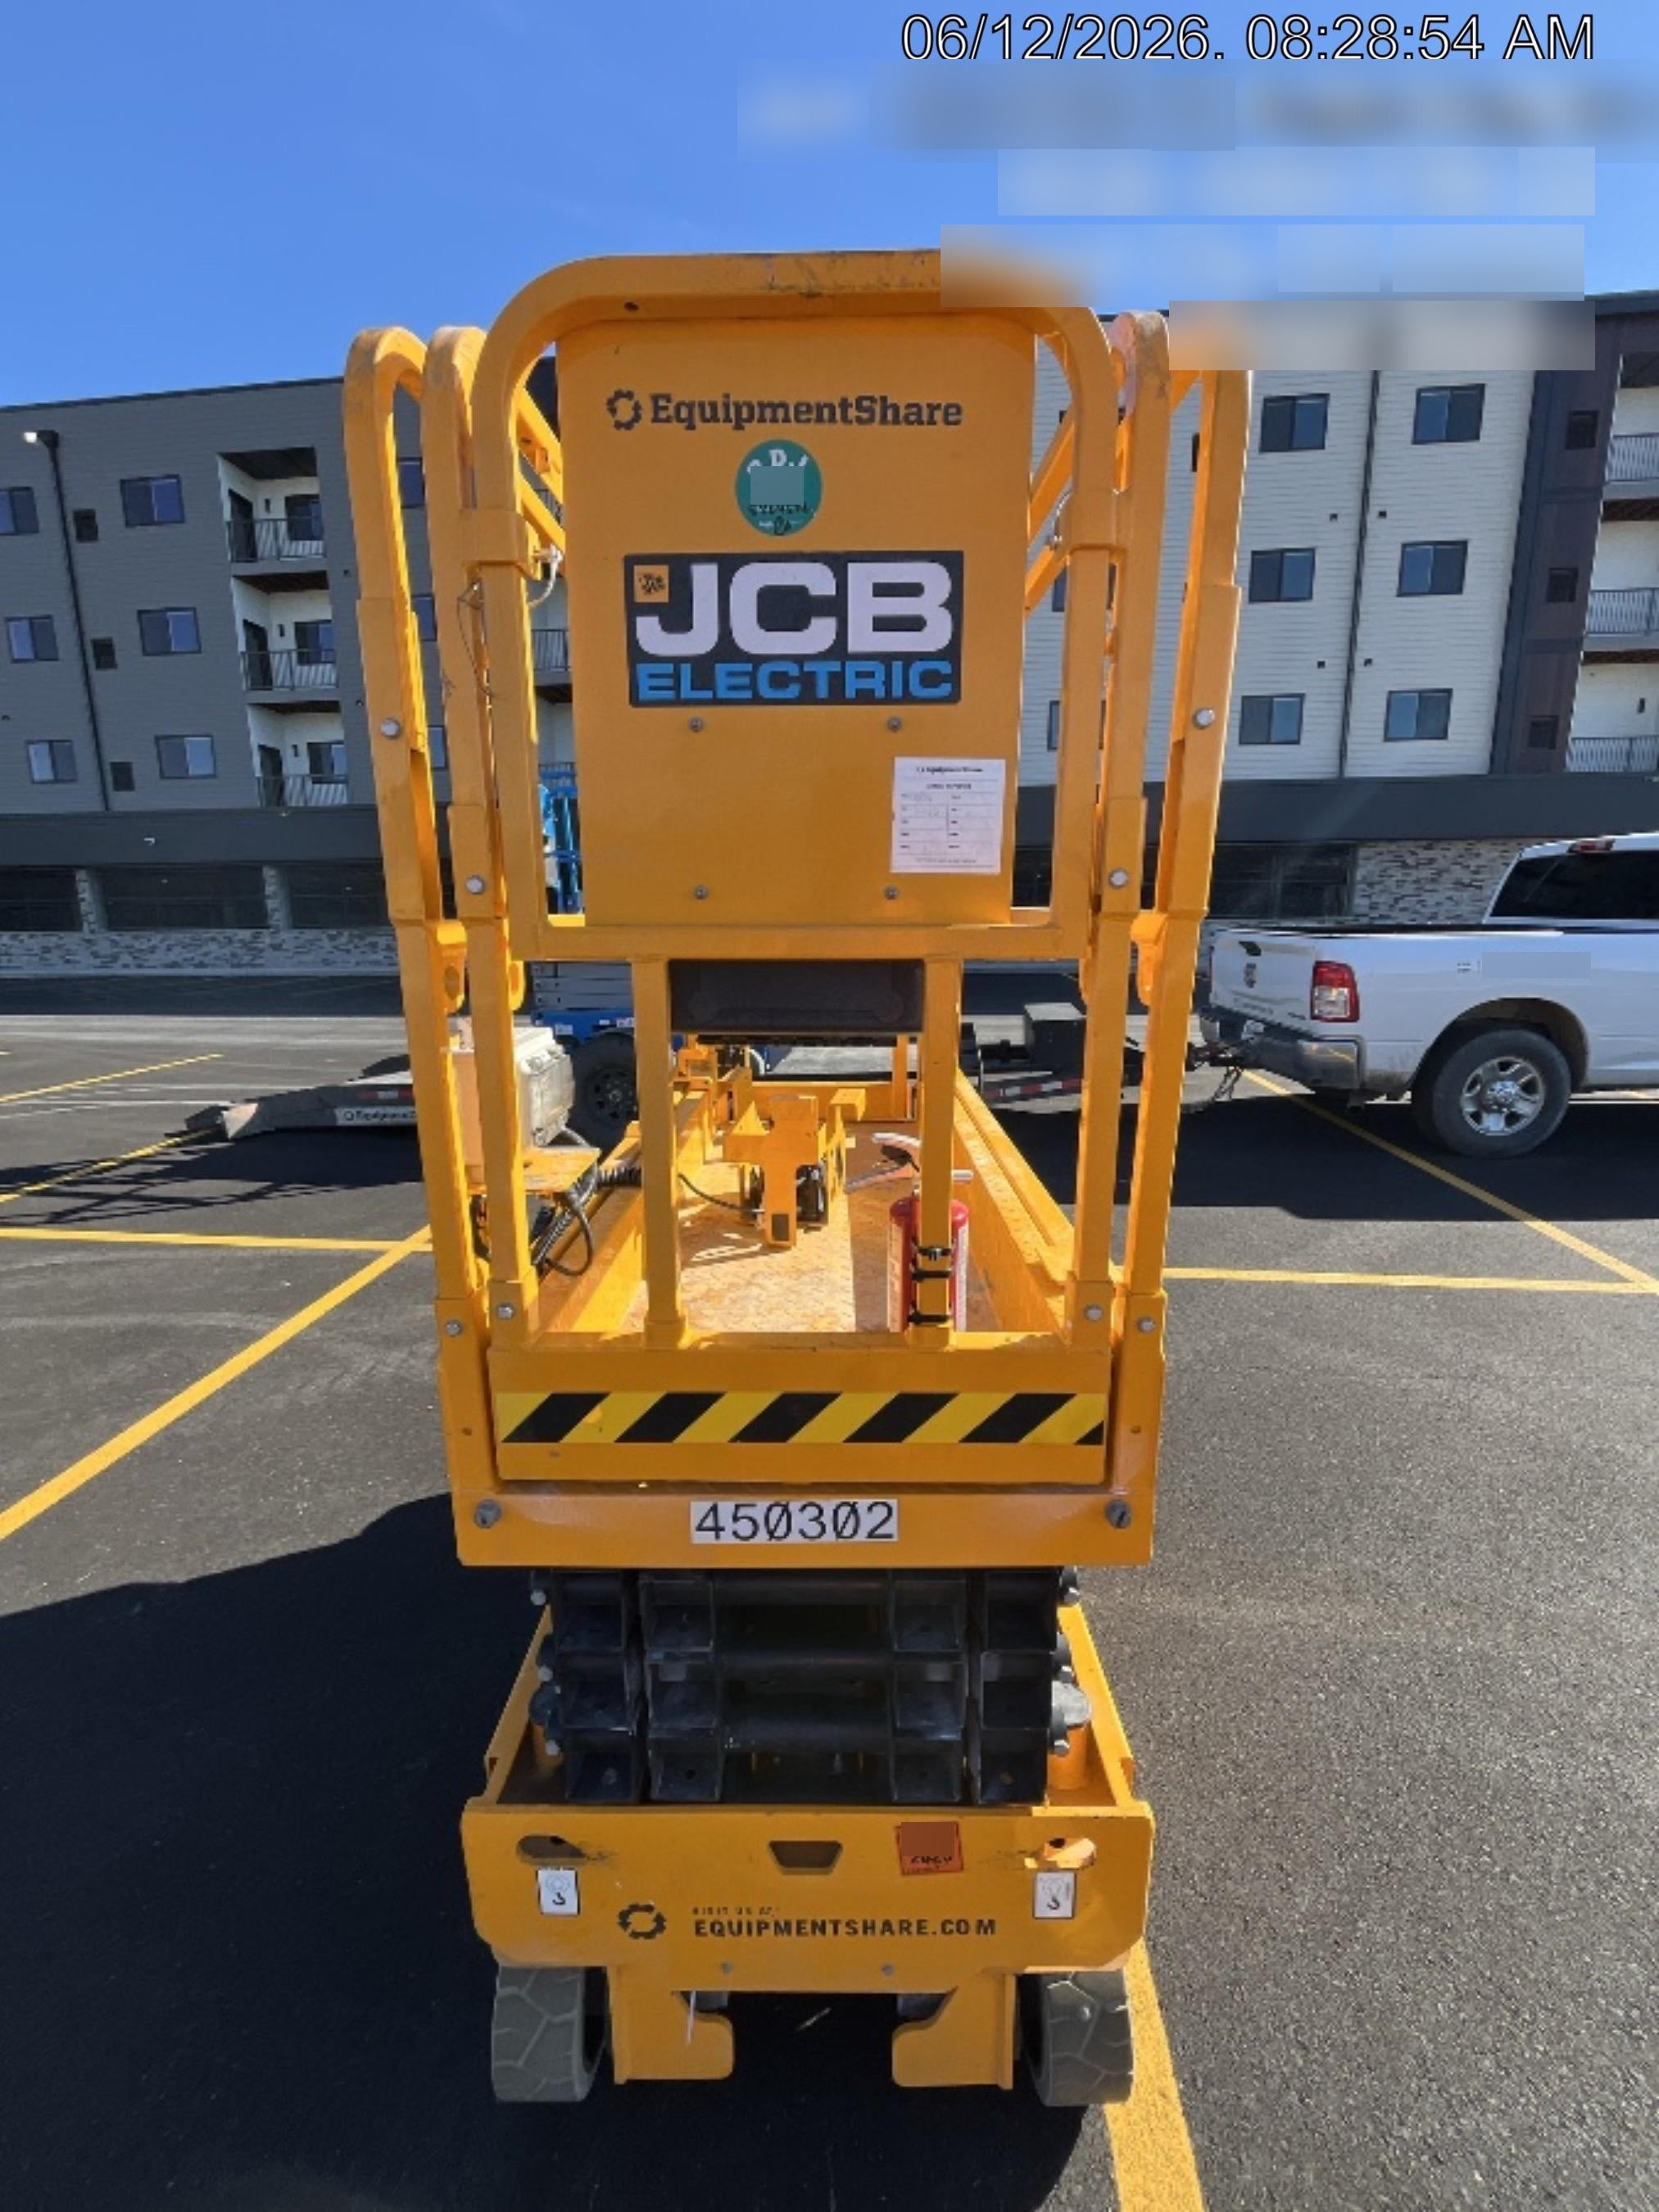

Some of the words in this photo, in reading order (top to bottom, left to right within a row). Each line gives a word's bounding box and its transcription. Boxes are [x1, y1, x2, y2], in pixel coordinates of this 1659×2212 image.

[650, 392, 963, 431] EquipmentShare
[635, 561, 954, 656] JCB
[636, 660, 953, 701] ELECTRIC
[695, 1500, 895, 1541] 450302
[694, 1919, 996, 1938] EQUIPMENTSHARE.COM
